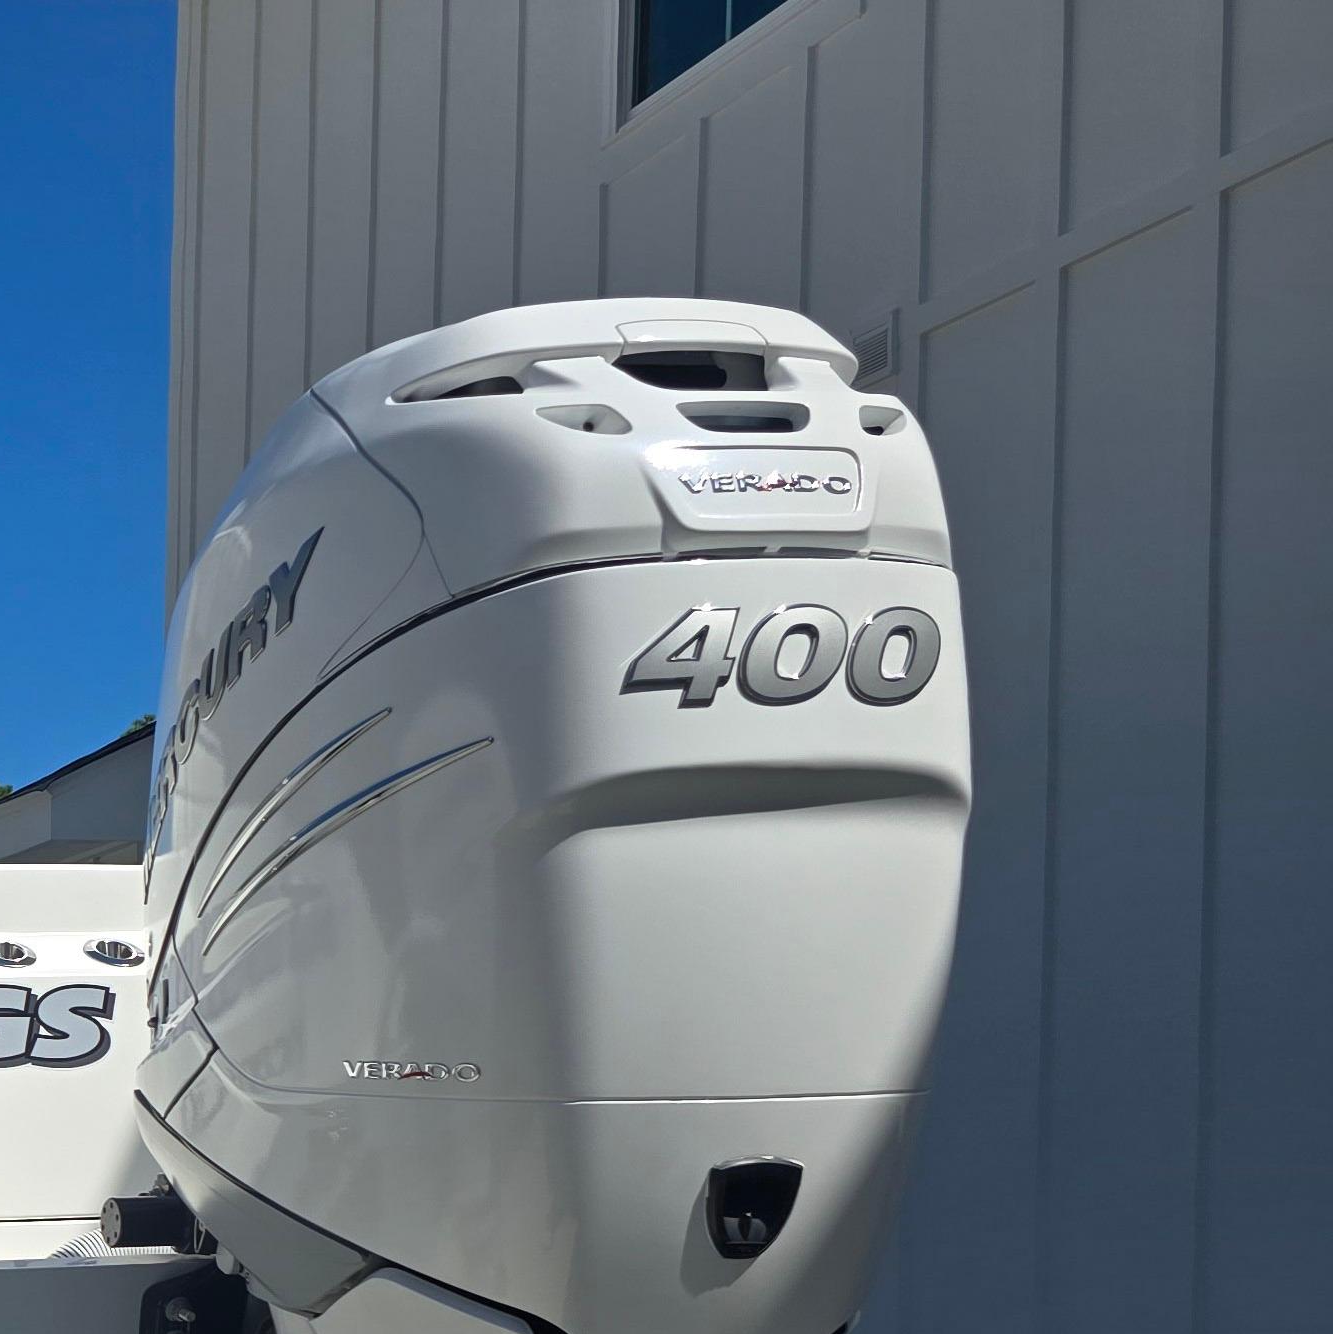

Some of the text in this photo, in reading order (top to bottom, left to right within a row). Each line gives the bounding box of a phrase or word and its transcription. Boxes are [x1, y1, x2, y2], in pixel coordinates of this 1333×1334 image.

[678, 471, 852, 494] VERADO
[619, 602, 942, 709] 400
[341, 1059, 482, 1083] VERADO
